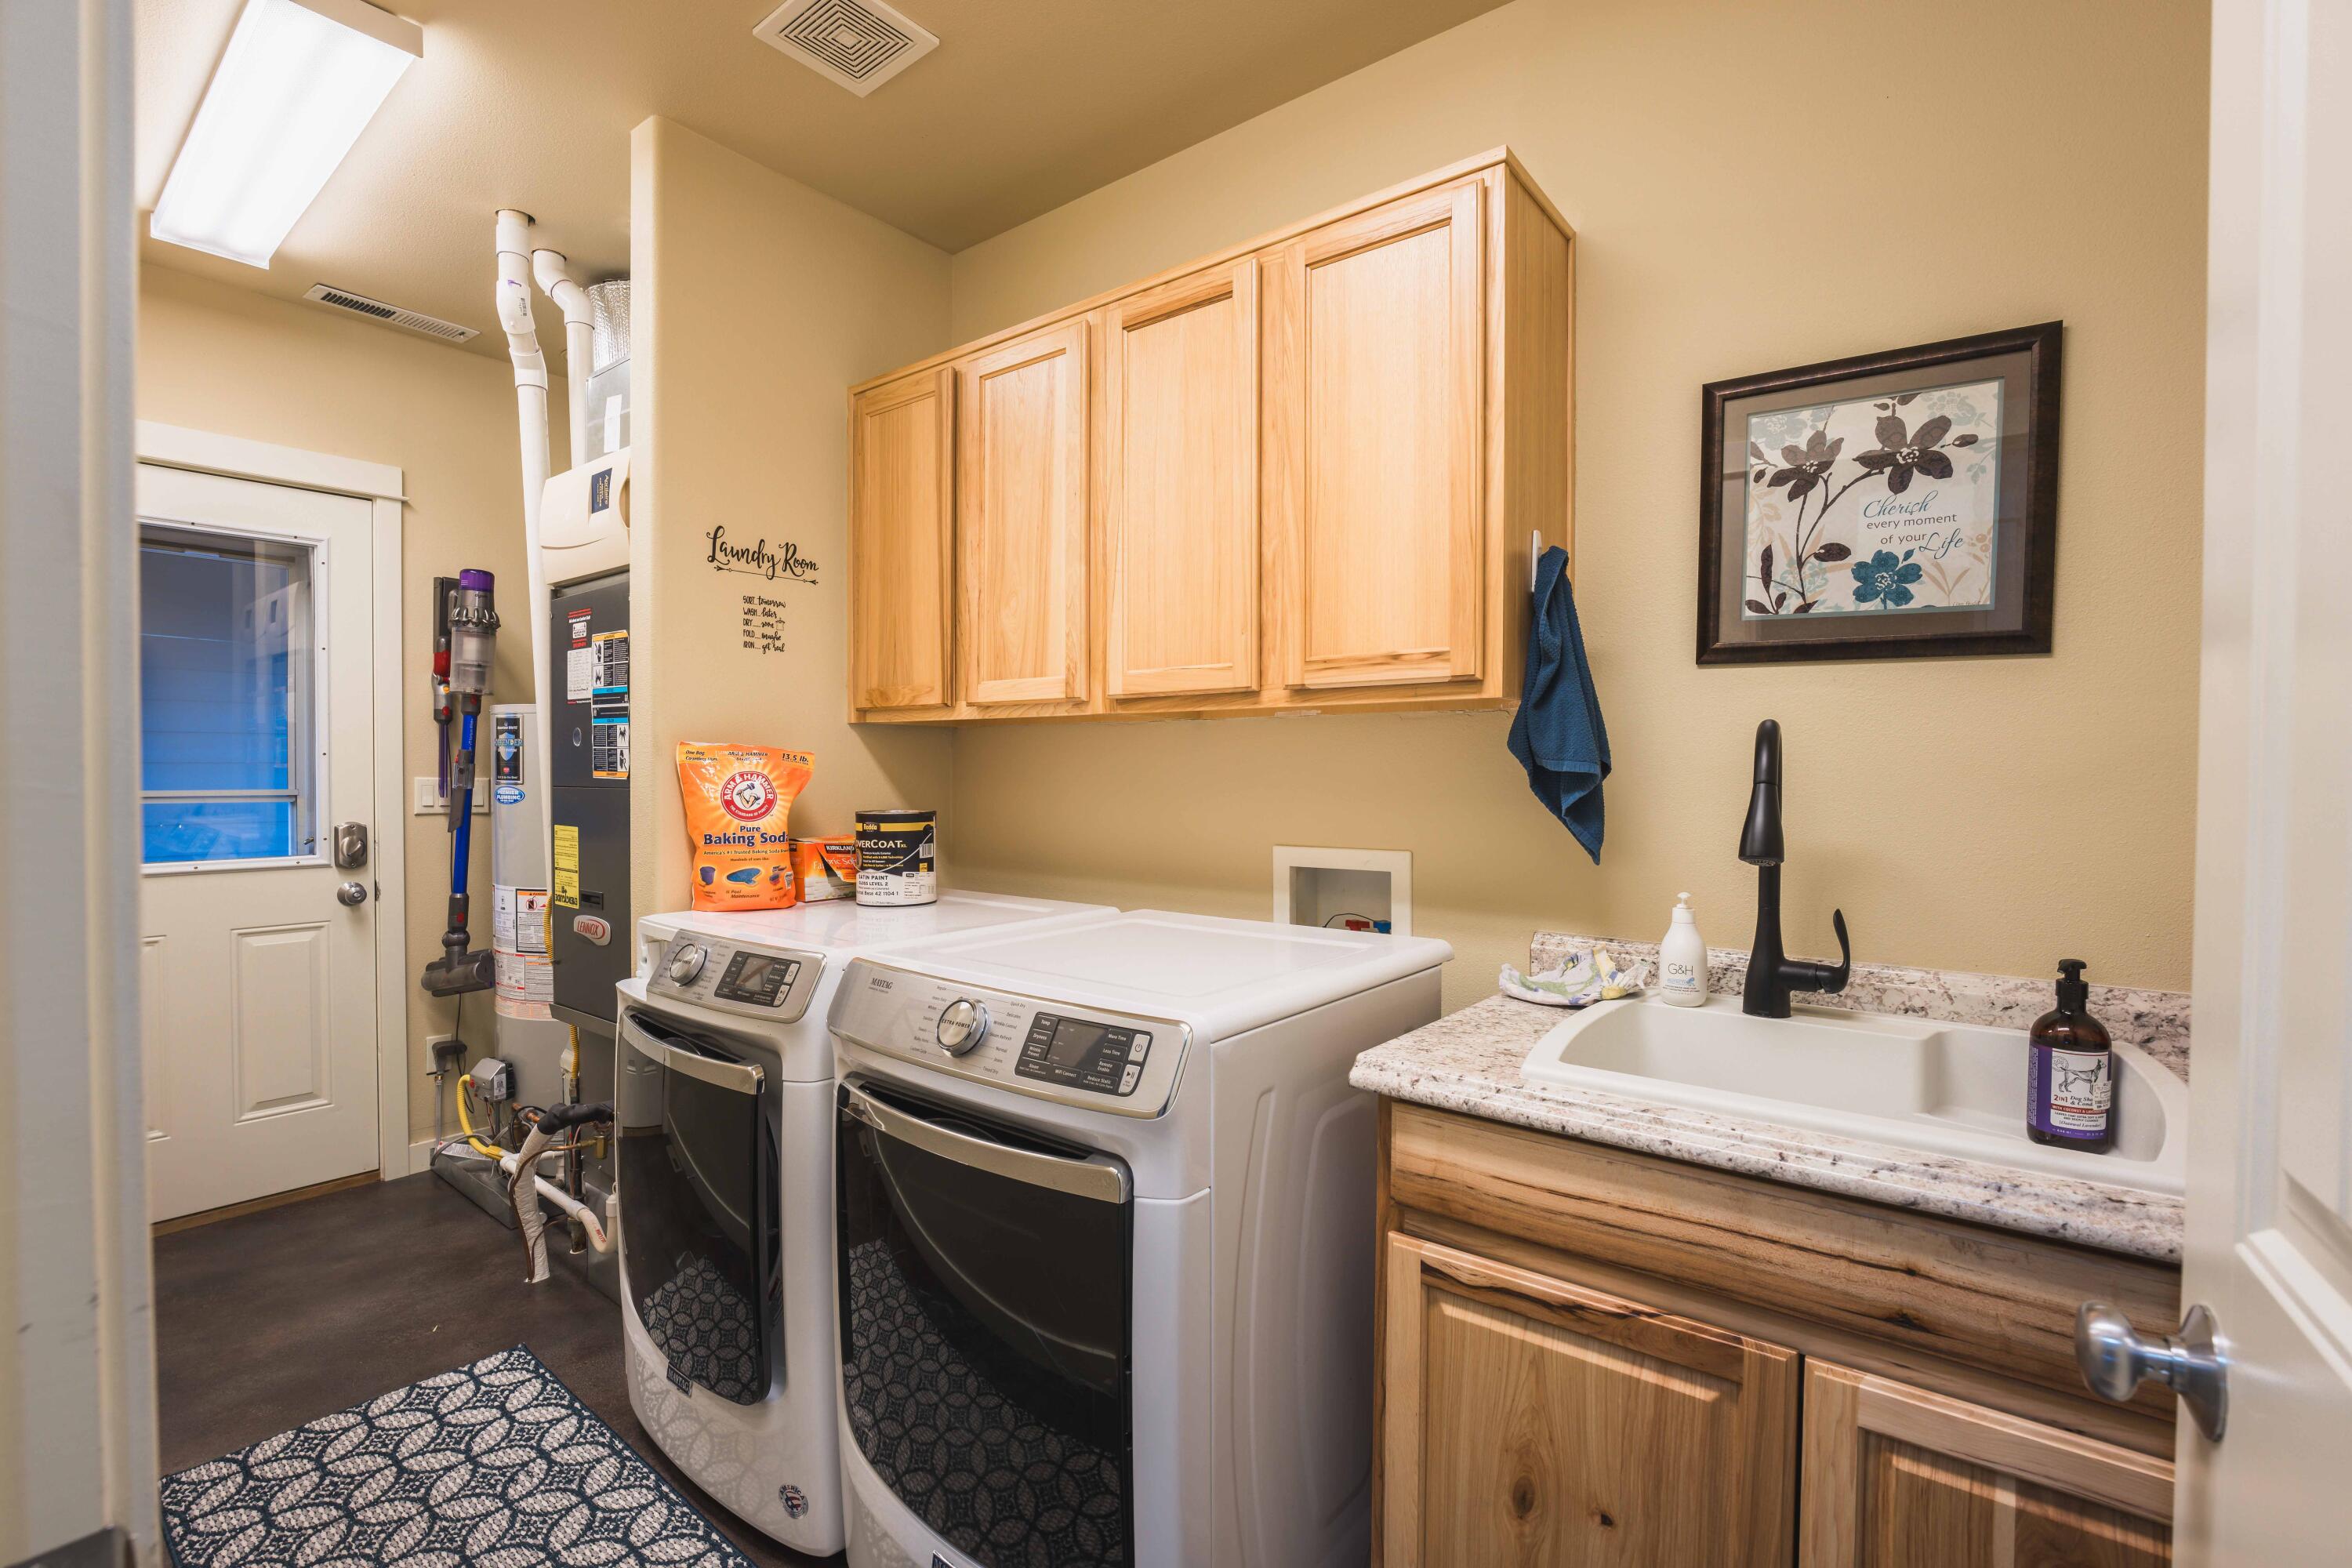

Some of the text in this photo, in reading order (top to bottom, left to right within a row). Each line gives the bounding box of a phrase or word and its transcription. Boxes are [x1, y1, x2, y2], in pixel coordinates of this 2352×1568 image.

[1864, 490, 1938, 517] Cherish
[1867, 514, 1957, 529] every moment
[1880, 528, 1963, 559] of your Life
[706, 525, 819, 580] Laundry Room
[757, 596, 786, 608] tomorrow
[761, 608, 777, 619] later
[761, 631, 781, 644] maybe
[762, 642, 771, 654] get
[773, 643, 785, 652] real
[782, 753, 797, 761] 13.5
[724, 781, 737, 800] ARM
[743, 773, 774, 800] HAMMER
[703, 833, 755, 847] Baking
[577, 920, 600, 937] LENNOX
[1668, 964, 1693, 976] G&H
[870, 978, 893, 989] MAYTAG
